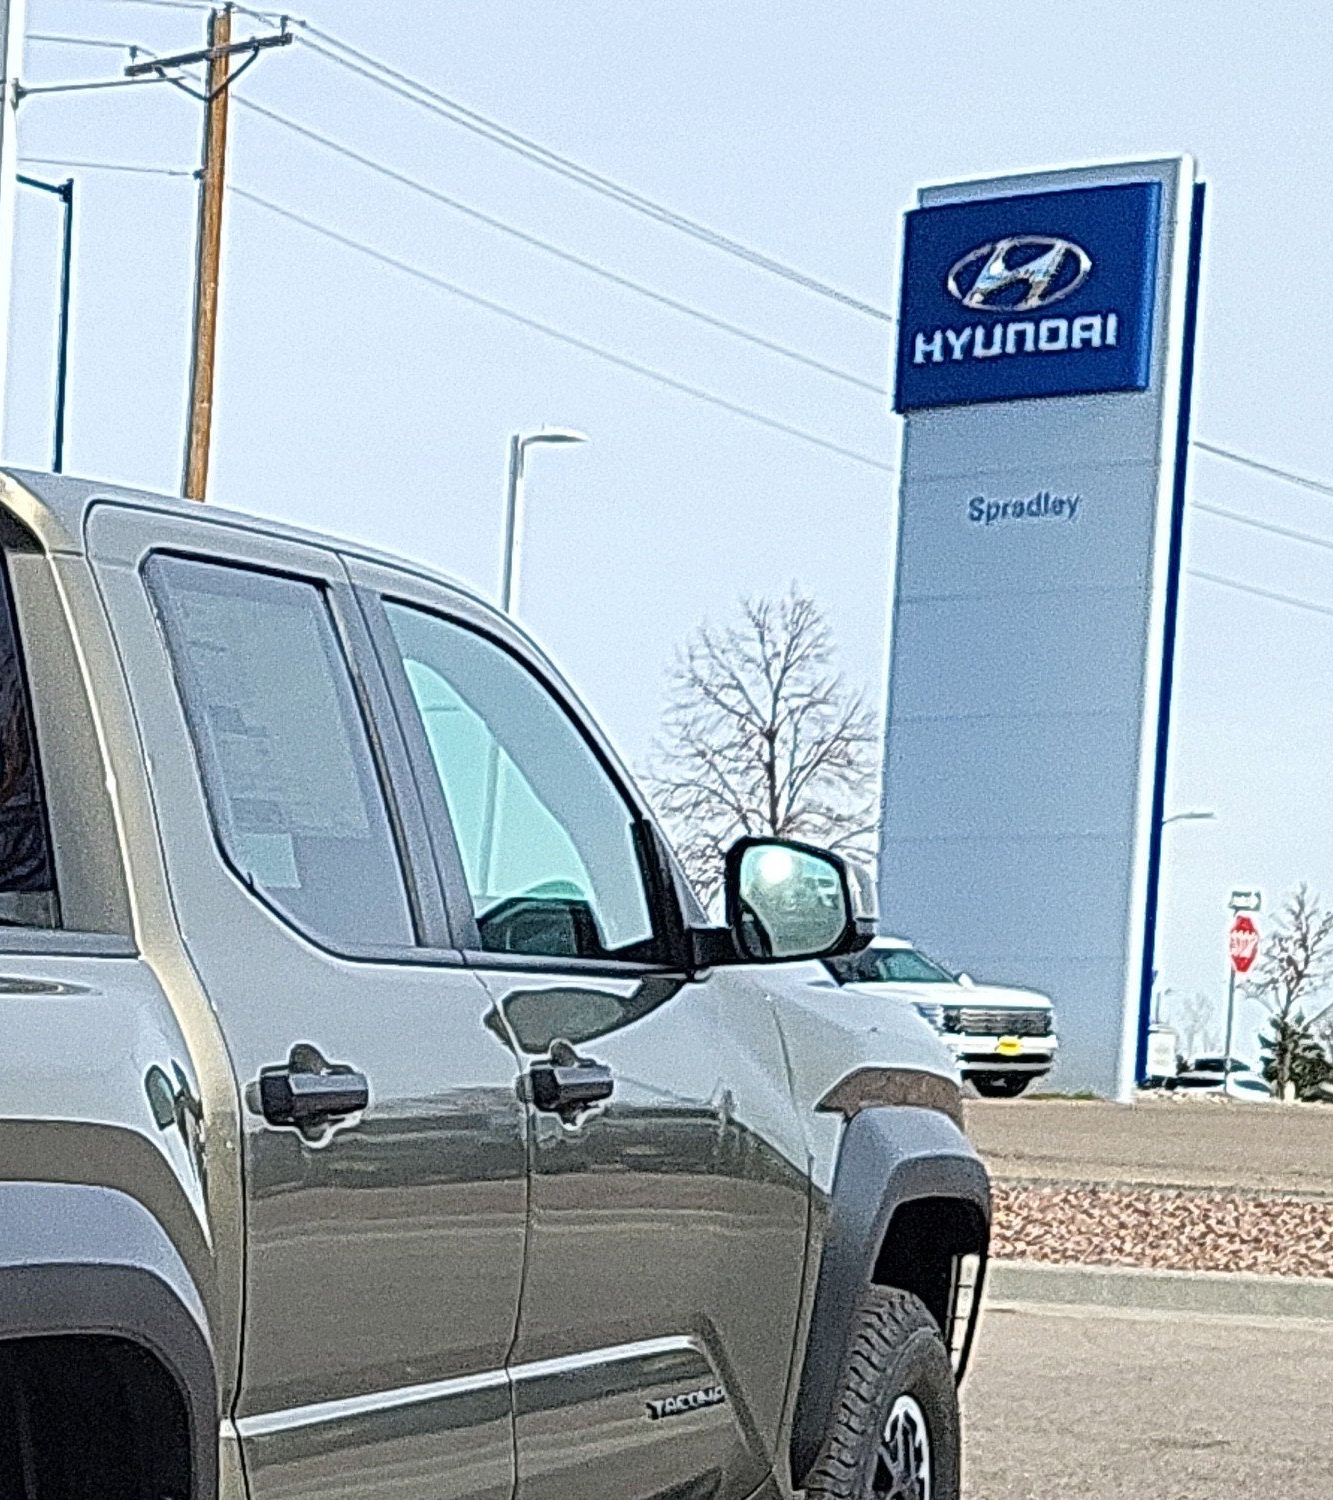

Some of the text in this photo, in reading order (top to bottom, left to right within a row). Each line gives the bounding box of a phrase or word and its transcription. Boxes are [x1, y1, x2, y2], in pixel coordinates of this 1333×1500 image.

[913, 312, 1118, 364] HYUNDAI
[968, 491, 1081, 525] Spradley
[645, 1386, 726, 1420] TACOMA
